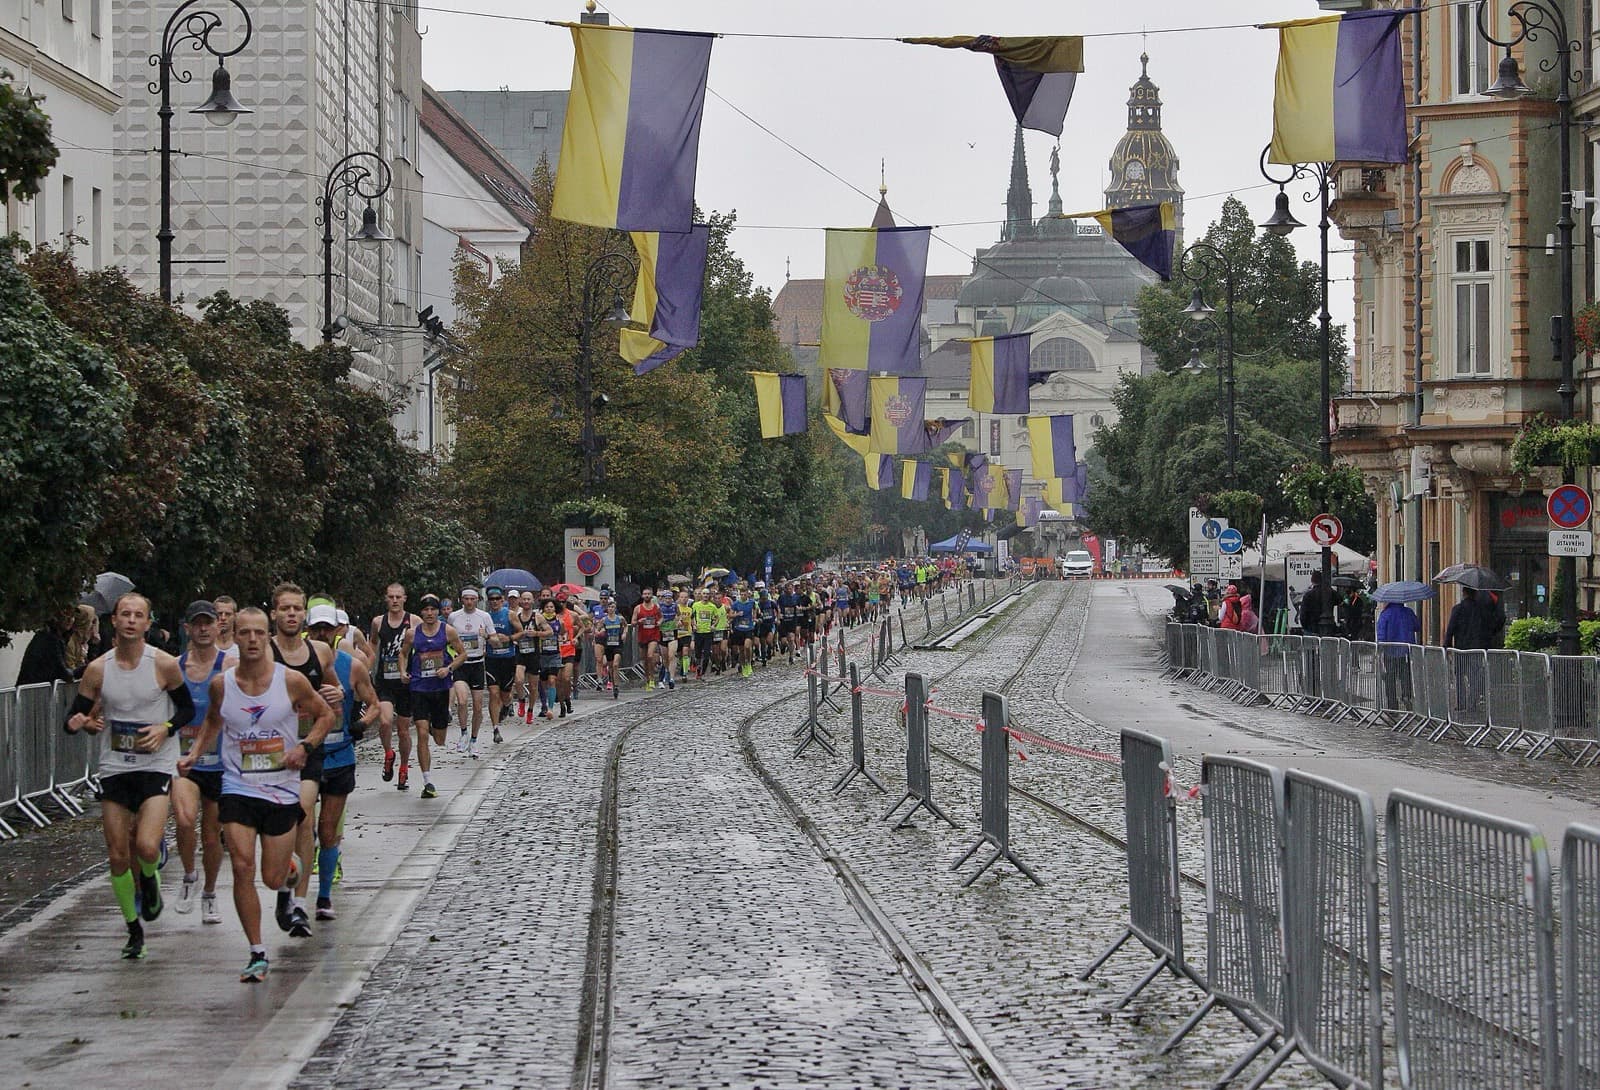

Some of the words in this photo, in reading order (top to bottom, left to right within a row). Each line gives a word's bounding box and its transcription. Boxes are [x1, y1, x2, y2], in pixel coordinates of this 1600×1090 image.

[572, 539, 584, 548] WC
[238, 729, 280, 740] NASA
[119, 734, 134, 750] 30
[249, 754, 272, 770] 185
